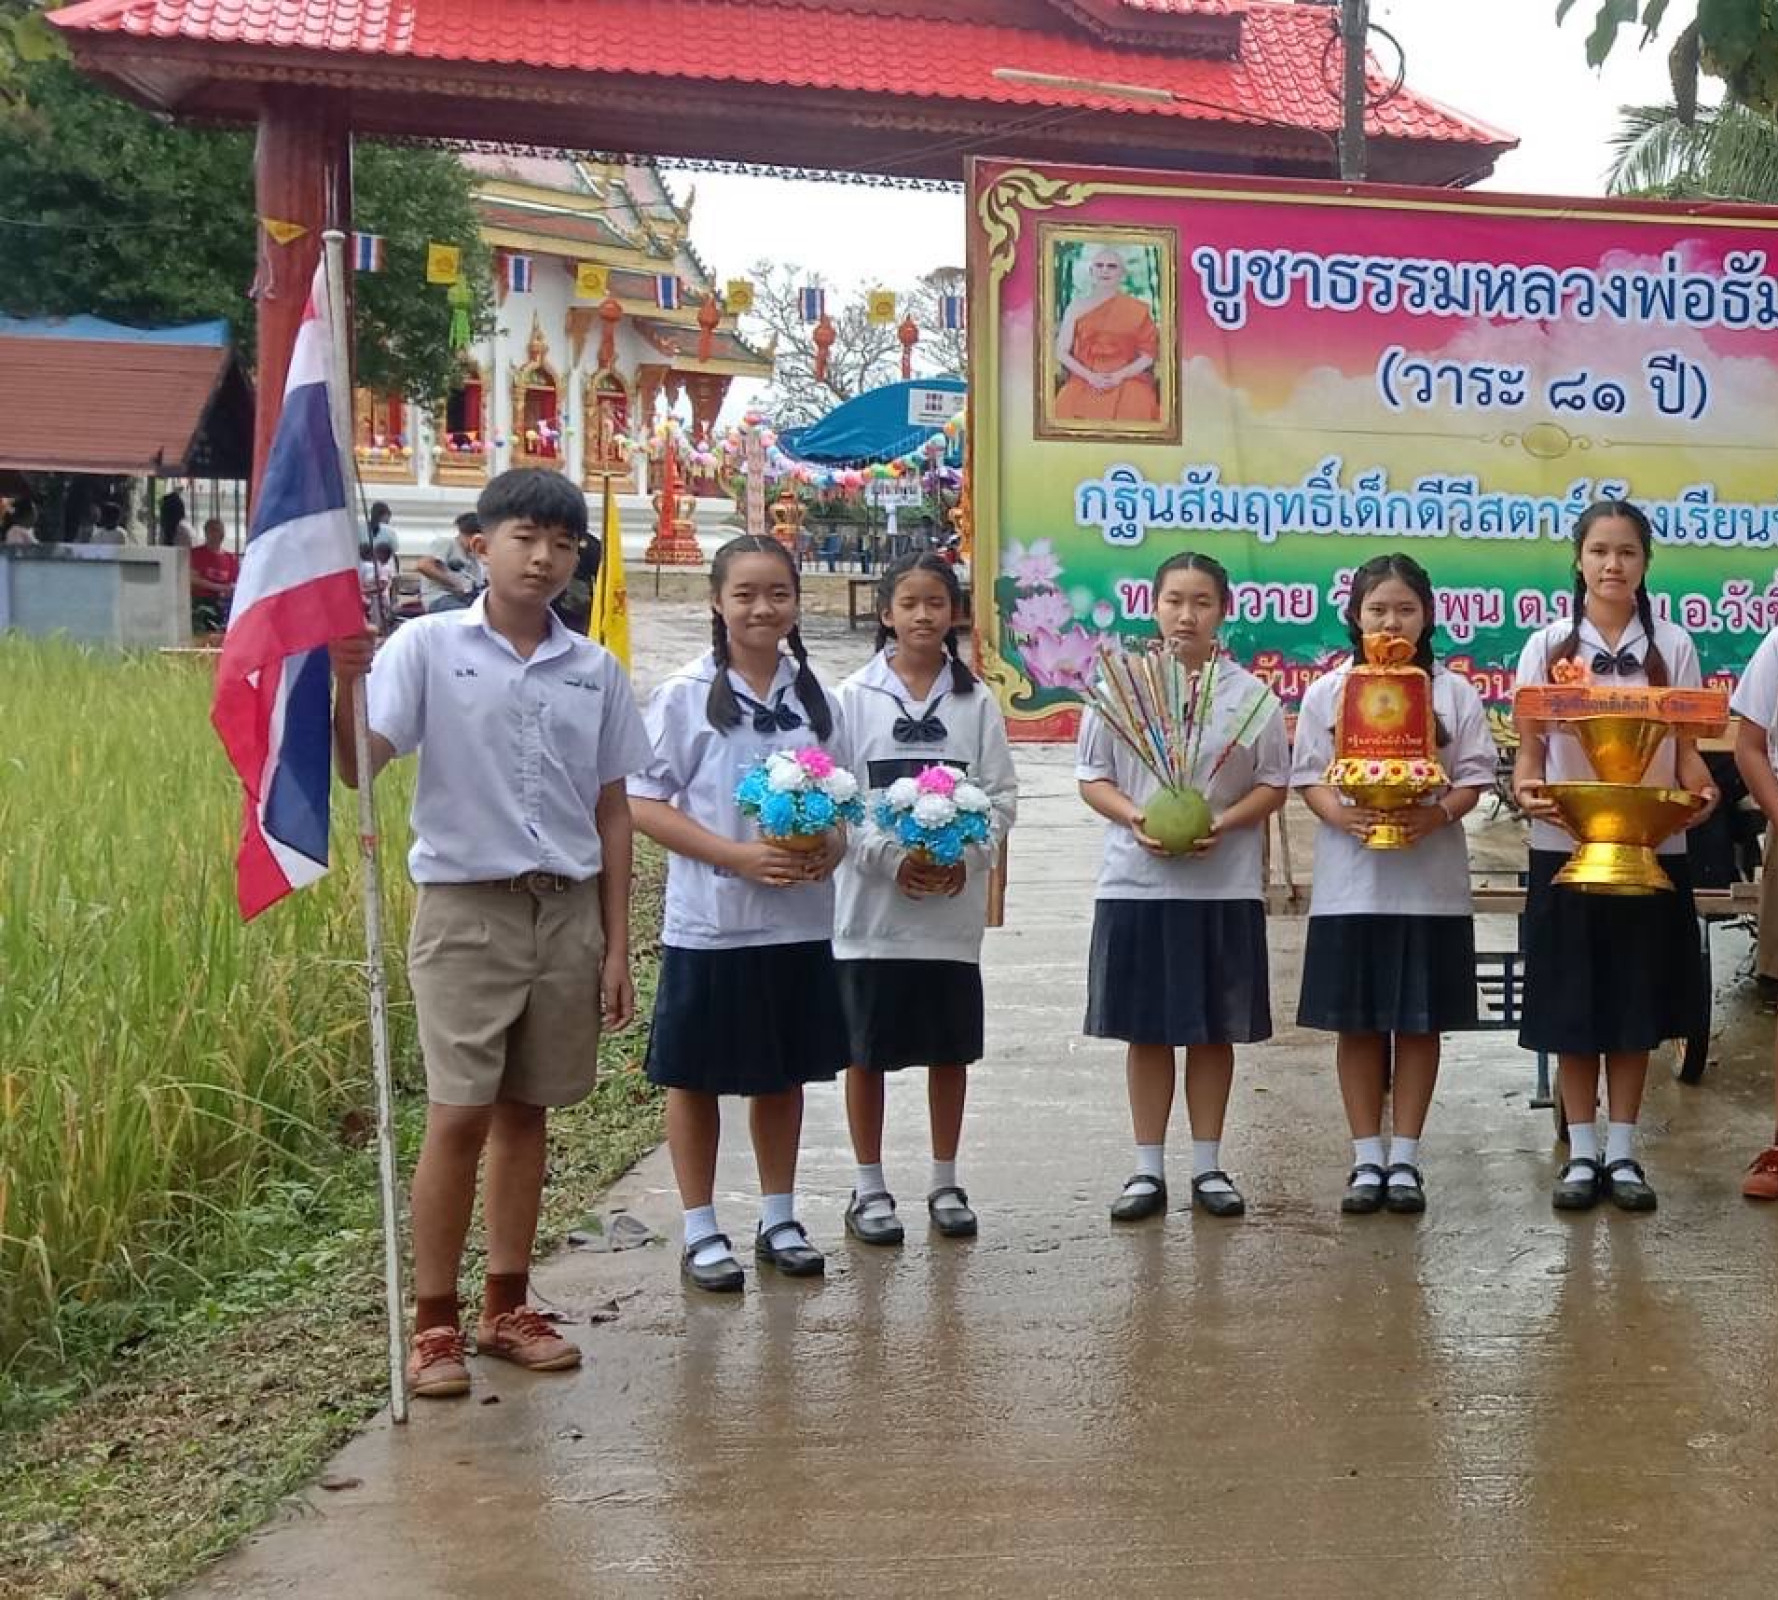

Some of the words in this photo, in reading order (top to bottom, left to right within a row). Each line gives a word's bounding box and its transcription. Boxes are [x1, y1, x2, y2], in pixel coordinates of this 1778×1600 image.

[1383, 351, 1526, 405] (วาระ
[1550, 372, 1625, 413] ๘๑
[1648, 354, 1707, 419] ปี)
